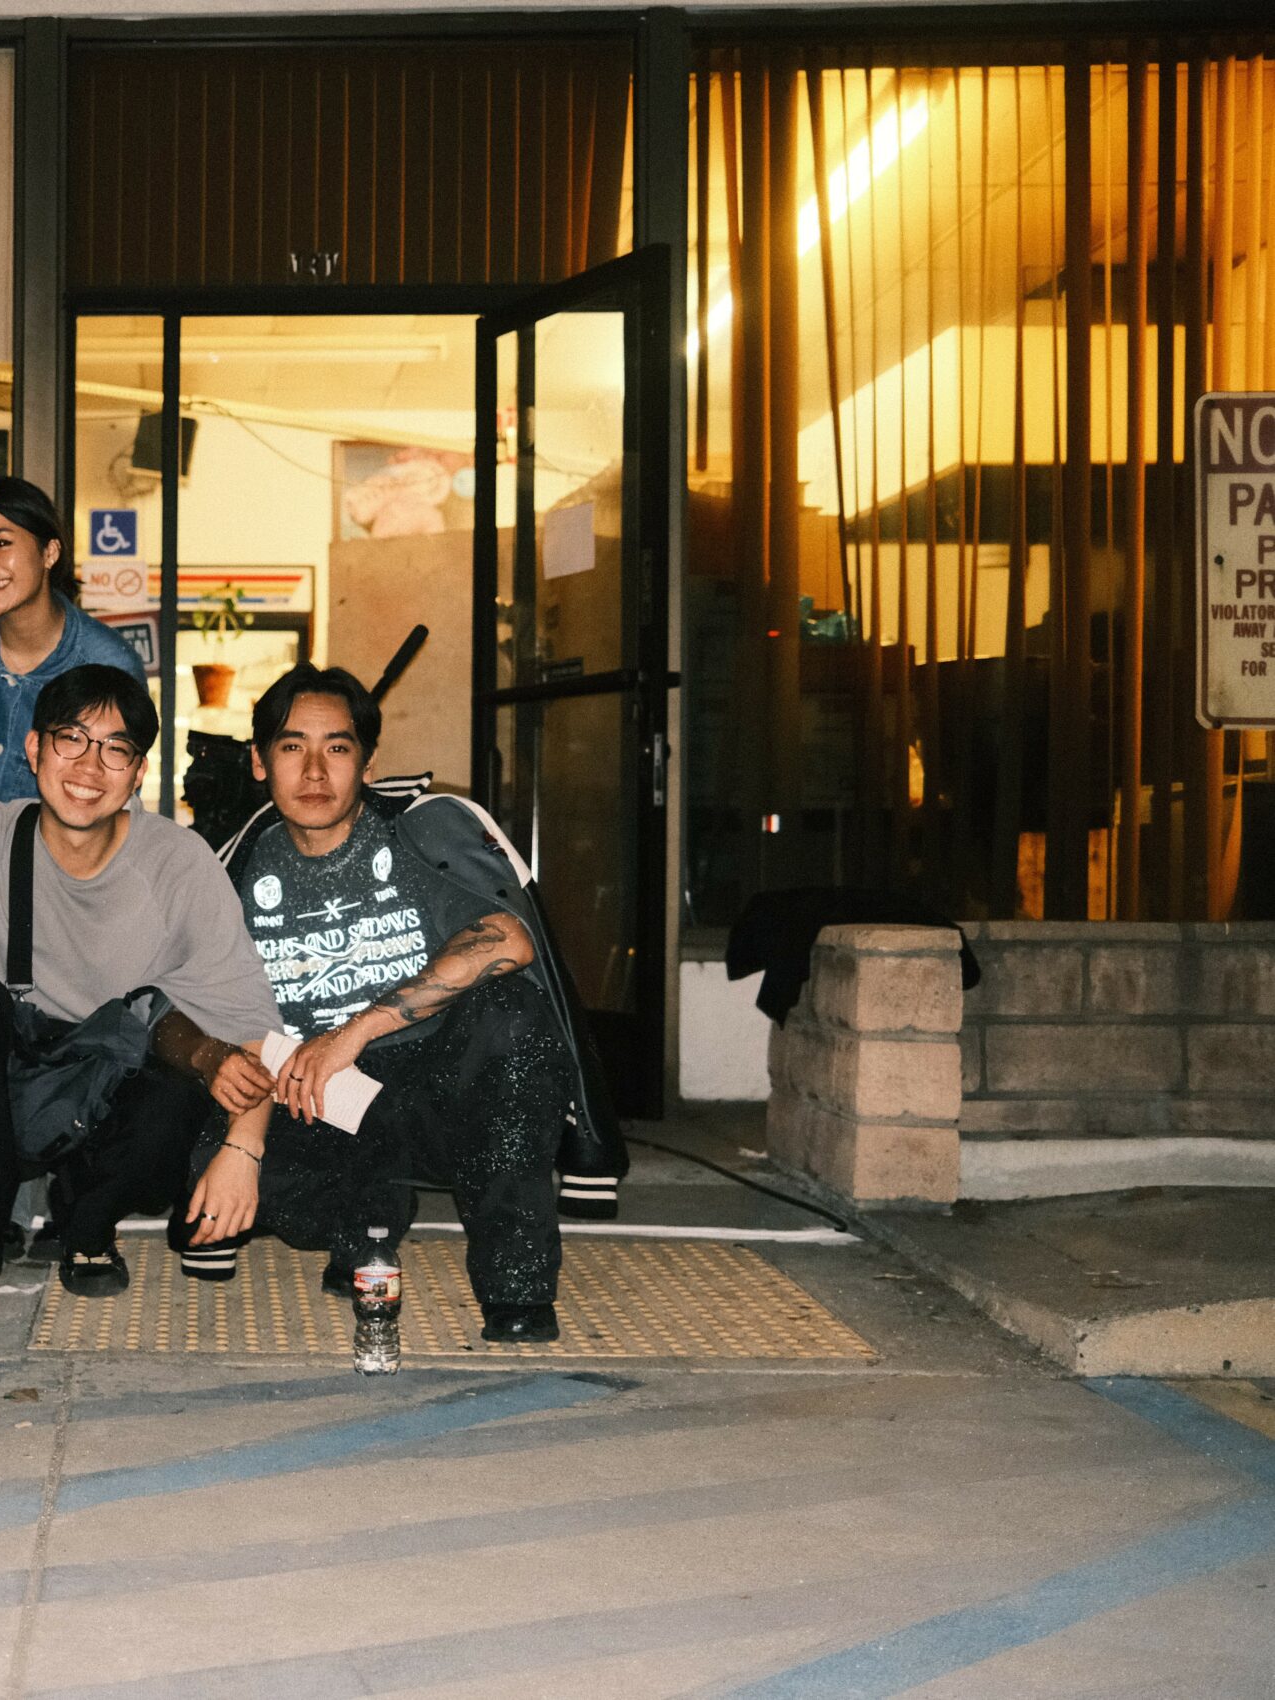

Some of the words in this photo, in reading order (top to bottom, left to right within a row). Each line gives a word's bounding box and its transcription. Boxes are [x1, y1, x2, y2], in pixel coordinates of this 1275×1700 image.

[1210, 406, 1275, 466] NO
[1229, 482, 1275, 527] PA
[1236, 569, 1275, 599] PR
[1211, 604, 1275, 620] VIOLATOR
[1233, 622, 1266, 638] AWAY
[1241, 660, 1267, 676] FOR
